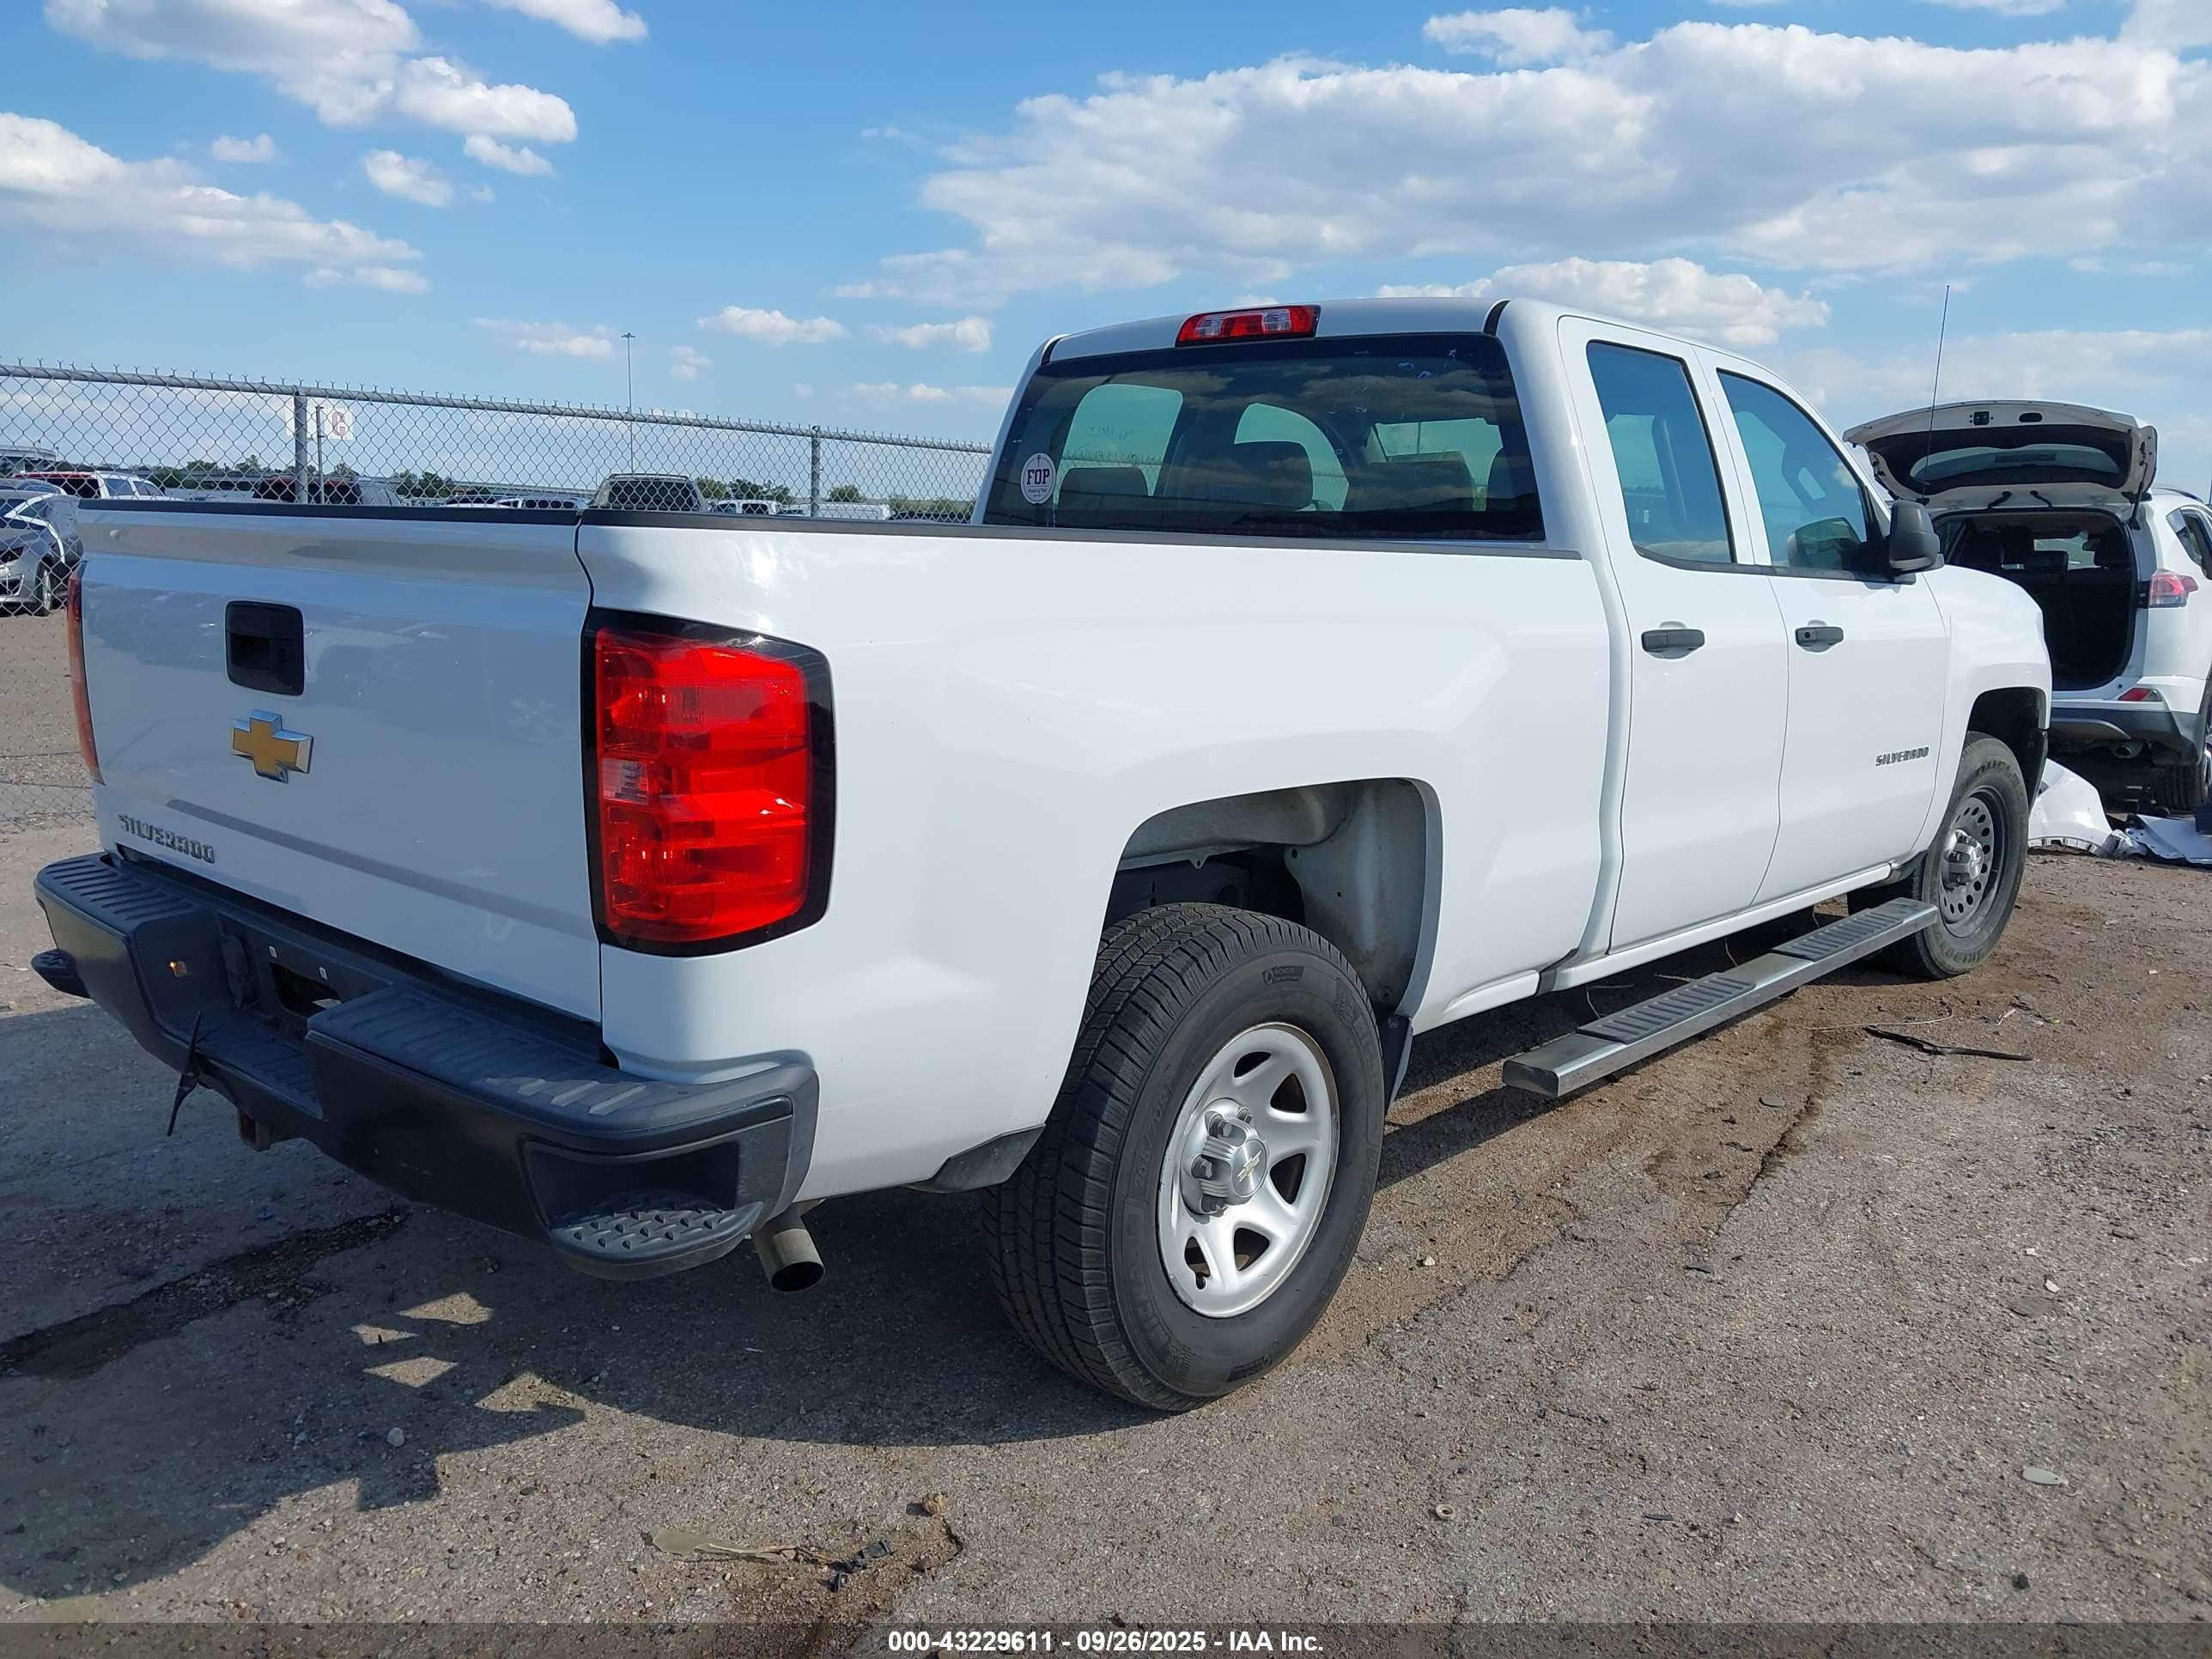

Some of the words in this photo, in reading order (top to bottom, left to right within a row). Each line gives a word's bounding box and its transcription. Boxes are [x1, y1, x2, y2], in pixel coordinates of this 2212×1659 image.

[1027, 469, 1049, 484] FOP
[1875, 746, 1929, 766] SILVERADO
[118, 814, 215, 864] SILVERADO
